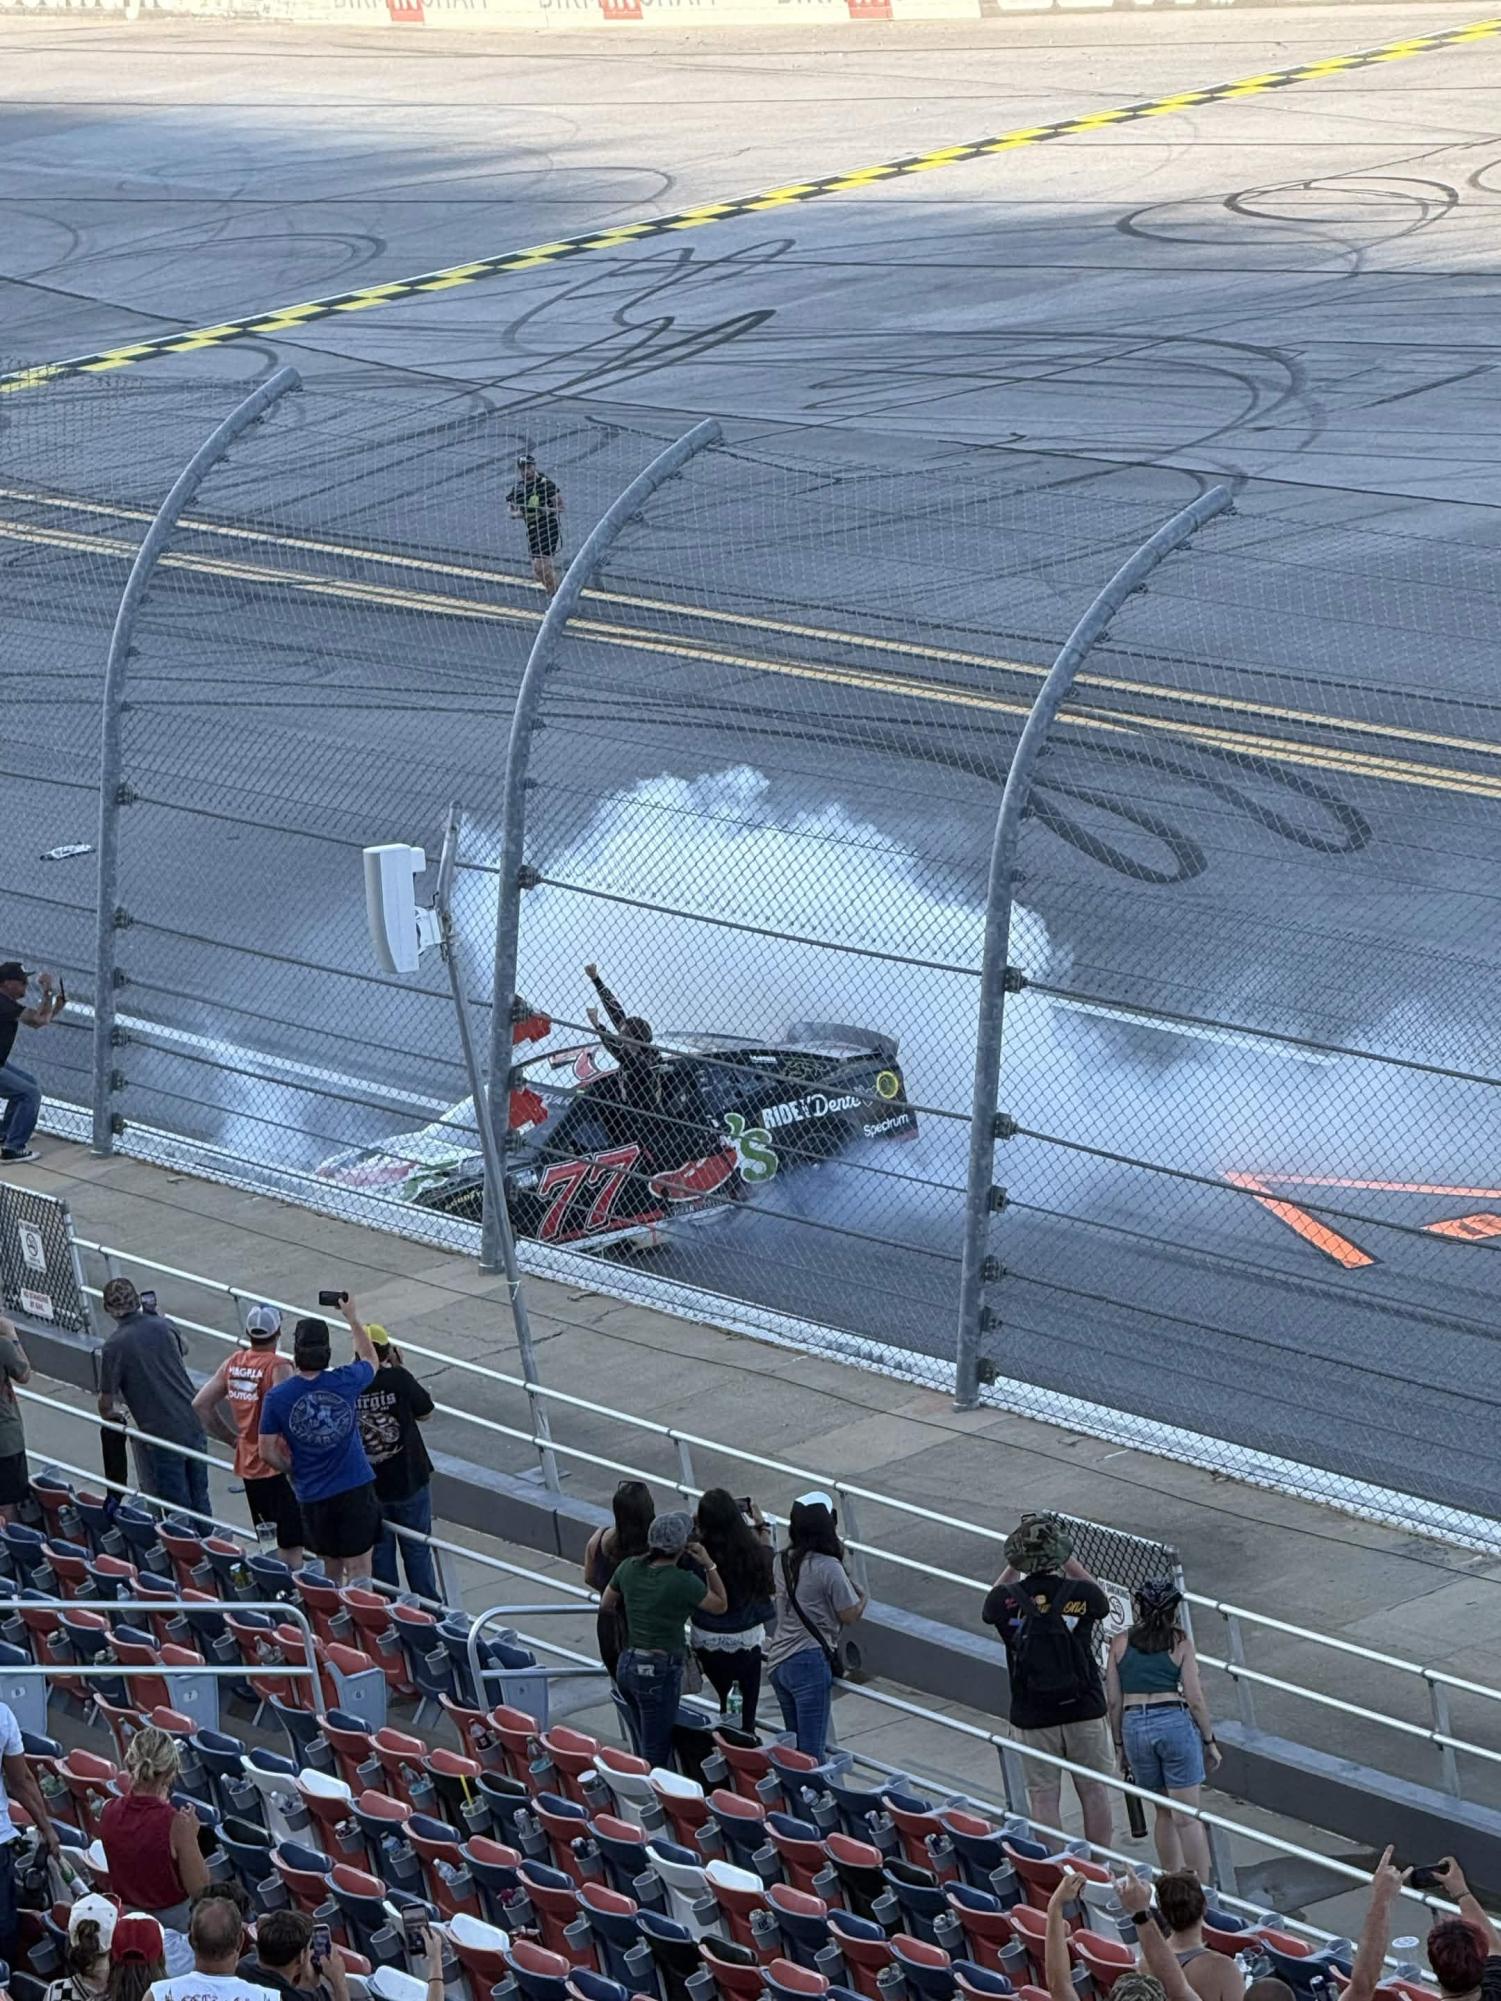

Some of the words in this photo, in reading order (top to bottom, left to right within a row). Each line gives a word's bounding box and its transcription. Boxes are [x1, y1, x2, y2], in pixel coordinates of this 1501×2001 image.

[762, 1099, 803, 1130] RIDE
[863, 1113, 909, 1138] Spectrum
[537, 1143, 640, 1241] 77
